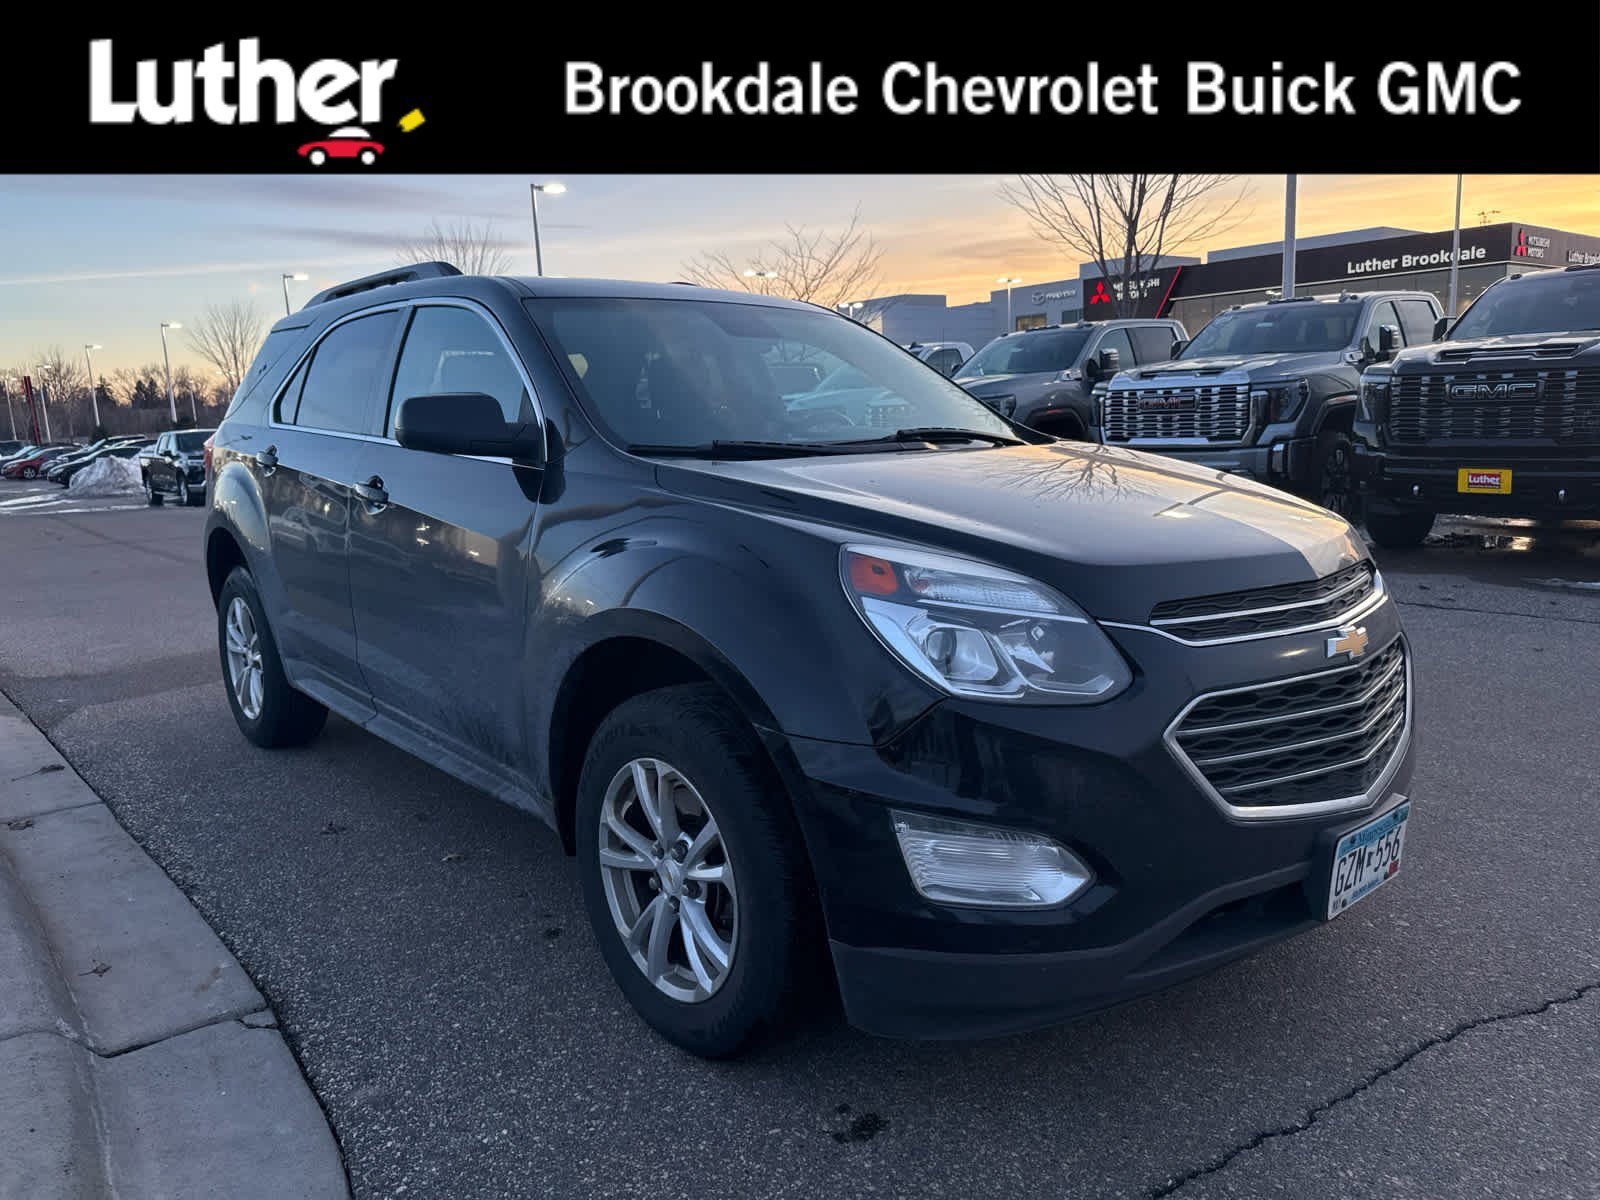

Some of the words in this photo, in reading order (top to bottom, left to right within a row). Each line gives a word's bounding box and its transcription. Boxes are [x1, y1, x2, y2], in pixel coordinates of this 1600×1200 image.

[1347, 257, 1398, 274] Luther
[1451, 383, 1537, 399] GMC
[1468, 474, 1500, 484] Luther
